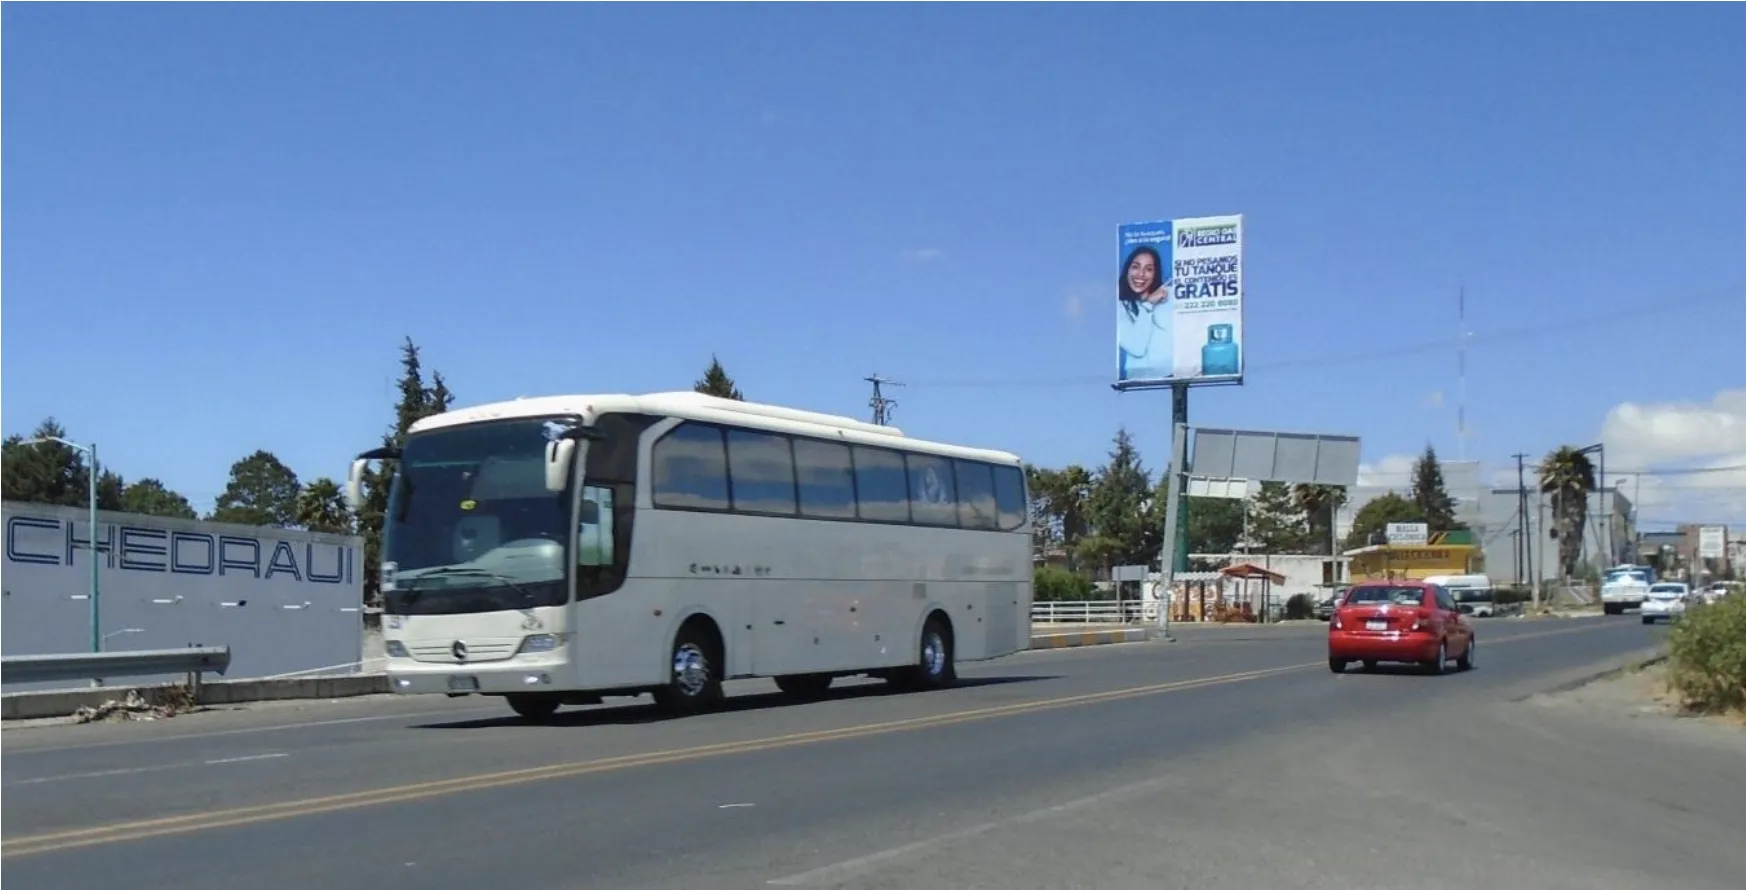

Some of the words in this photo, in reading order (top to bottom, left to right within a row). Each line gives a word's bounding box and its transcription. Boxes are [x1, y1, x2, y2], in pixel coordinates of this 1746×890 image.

[1183, 258, 1195, 266] NO
[1196, 256, 1237, 265] PESAMOS
[1174, 267, 1189, 277] TU
[1193, 263, 1237, 276] TANQUE
[1184, 274, 1227, 284] CONTENIDO
[1229, 273, 1238, 281] ES
[1174, 281, 1238, 300] GRATIS
[6, 516, 354, 585] CHEDRAUI
